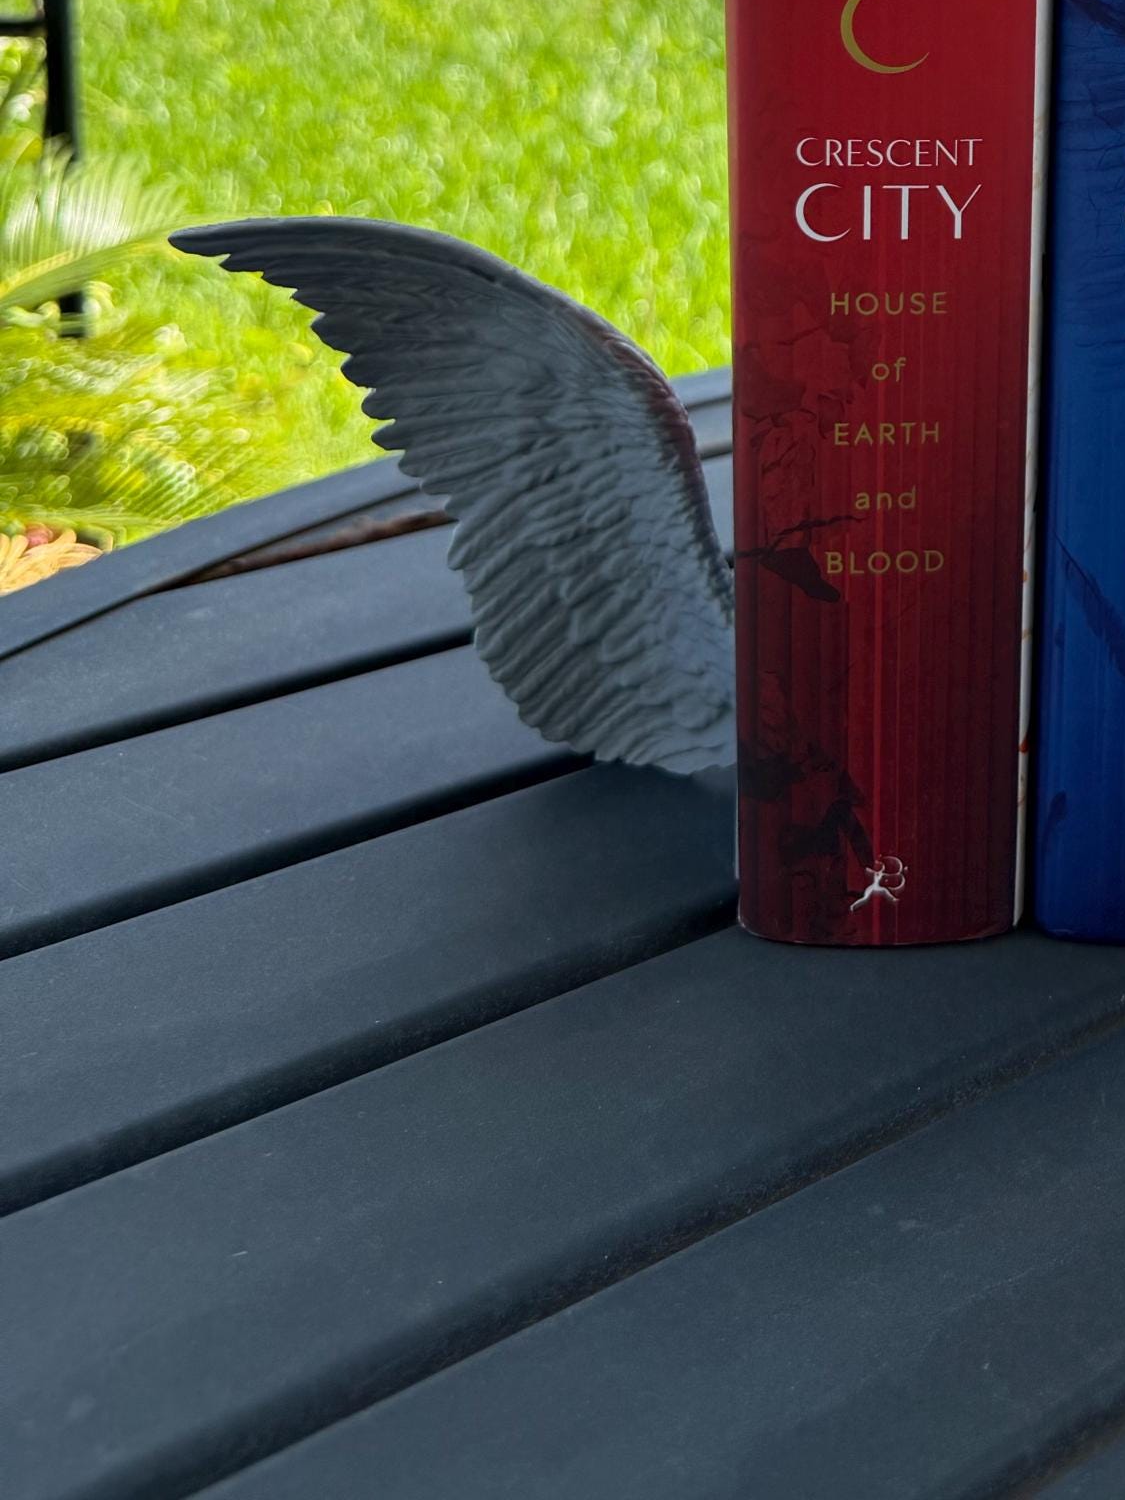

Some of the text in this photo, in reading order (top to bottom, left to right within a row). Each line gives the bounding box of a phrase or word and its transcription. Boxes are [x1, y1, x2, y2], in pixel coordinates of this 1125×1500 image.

[796, 137, 983, 167] CRESCENT
[795, 182, 982, 242] CITY
[830, 291, 947, 316] HOUSE
[871, 356, 907, 383] of
[834, 421, 939, 446] EARTH
[854, 485, 916, 511] and
[824, 549, 945, 576] BLOOD
